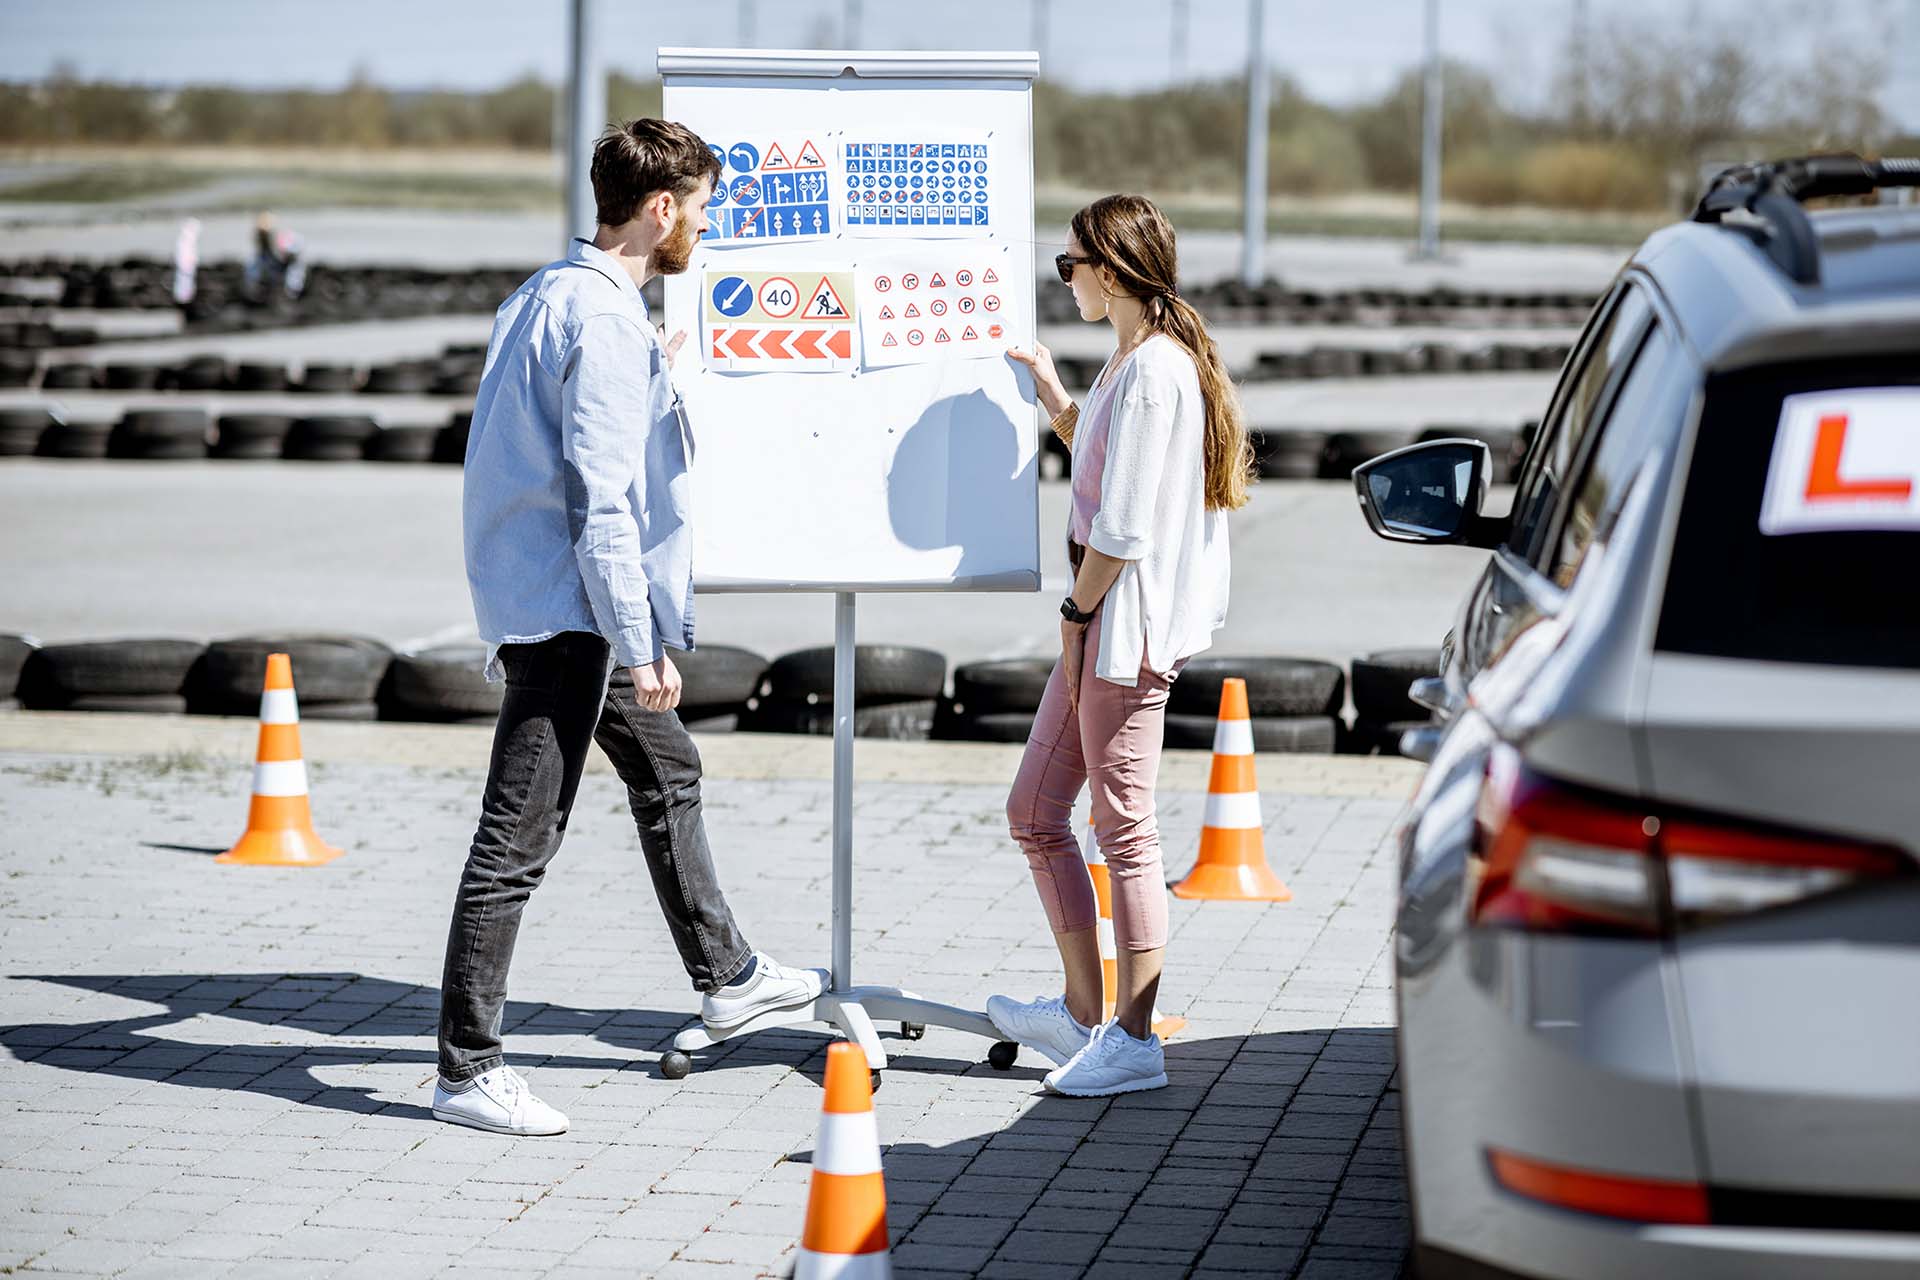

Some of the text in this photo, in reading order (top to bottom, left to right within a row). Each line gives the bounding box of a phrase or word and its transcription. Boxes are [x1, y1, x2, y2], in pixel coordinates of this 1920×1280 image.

[864, 177, 875, 186] 30
[960, 274, 970, 282] 40
[767, 289, 791, 306] 40
[964, 301, 971, 310] P
[1804, 415, 1911, 500] L
